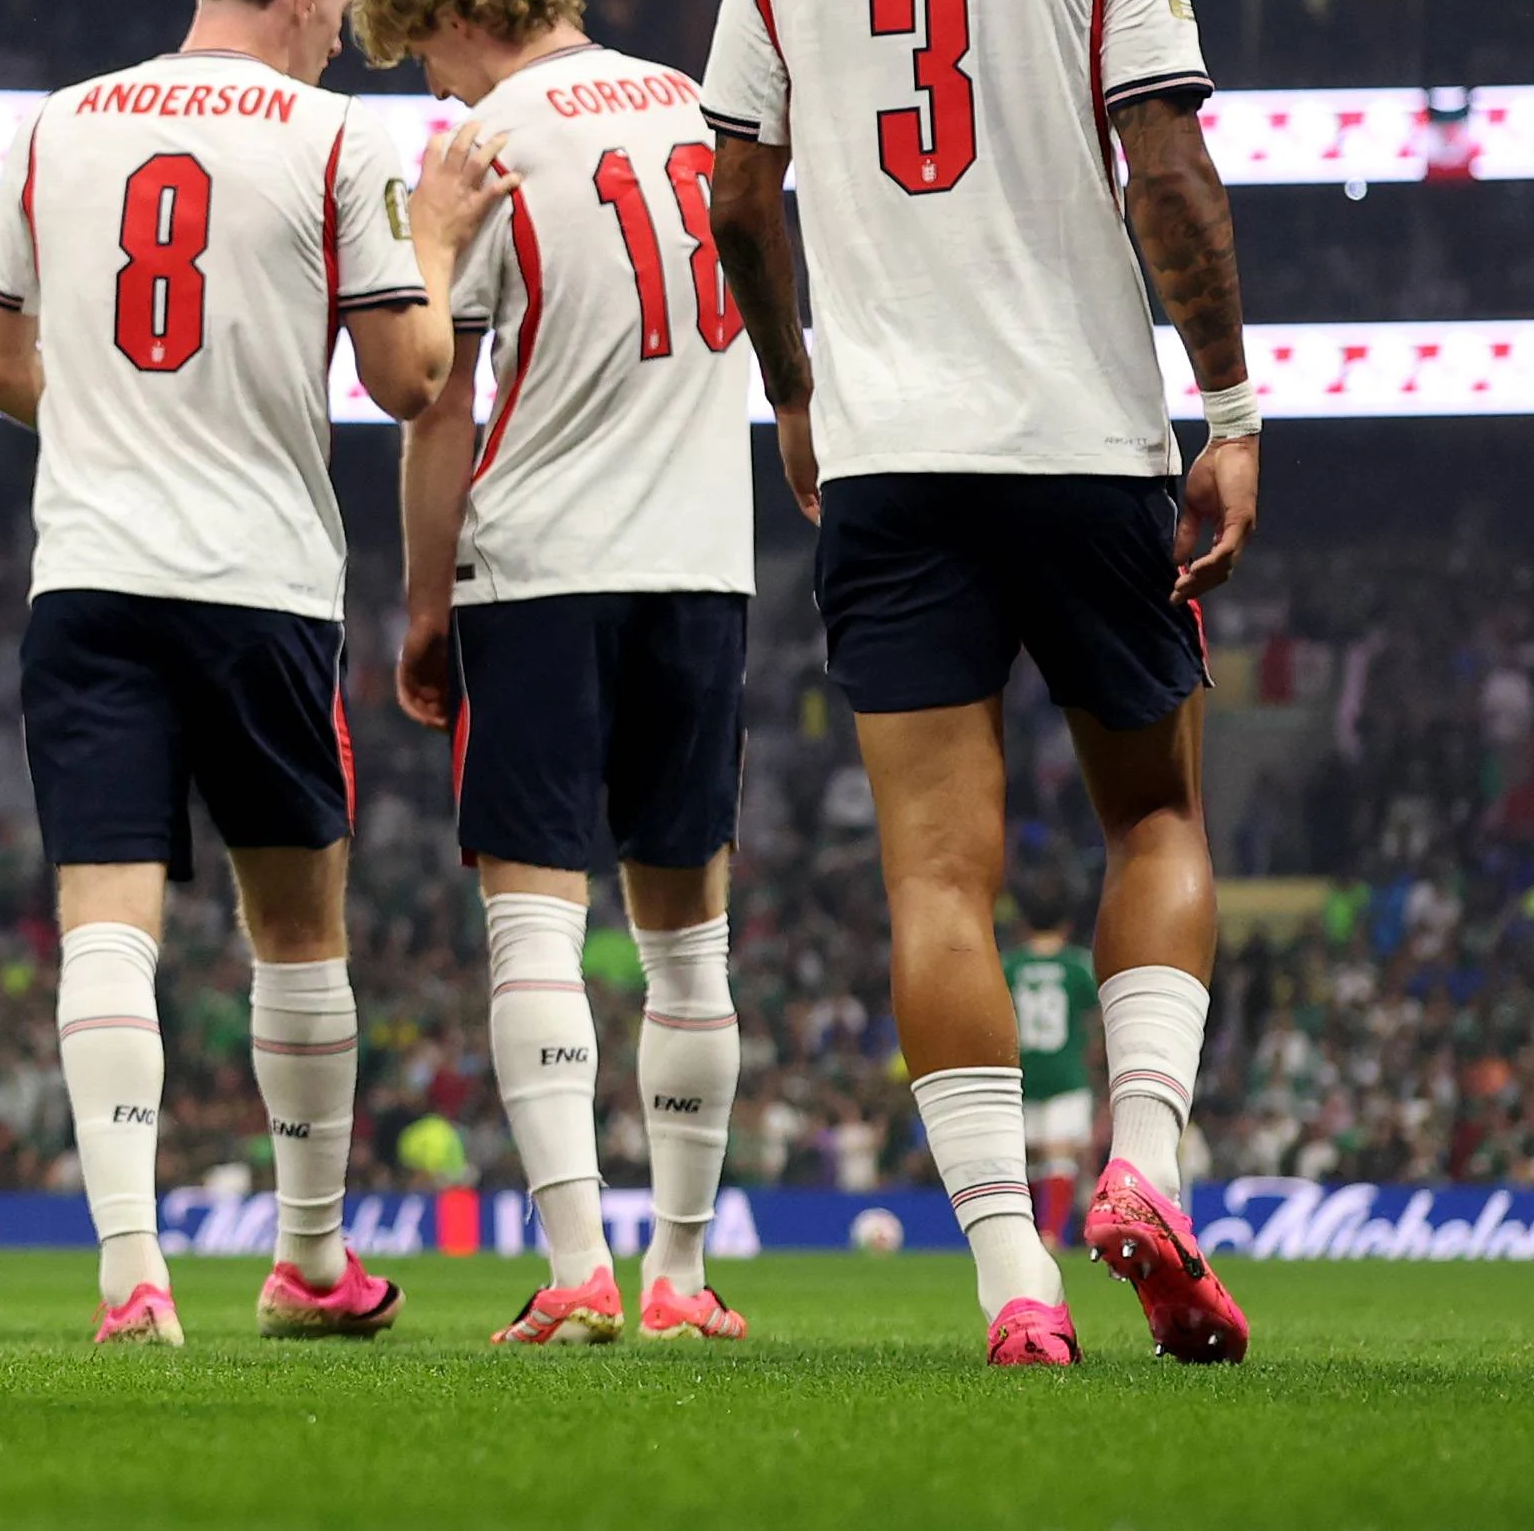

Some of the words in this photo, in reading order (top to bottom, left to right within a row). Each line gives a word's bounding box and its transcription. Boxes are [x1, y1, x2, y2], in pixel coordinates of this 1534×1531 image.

[76, 83, 297, 124] ANDERSON
[546, 71, 701, 119] GORDON
[115, 152, 213, 372] 8
[593, 143, 745, 361] 18
[541, 1046, 589, 1066] ENG
[112, 1104, 156, 1126] ENG
[654, 1093, 702, 1114] ENG
[272, 1117, 311, 1139] ENG
